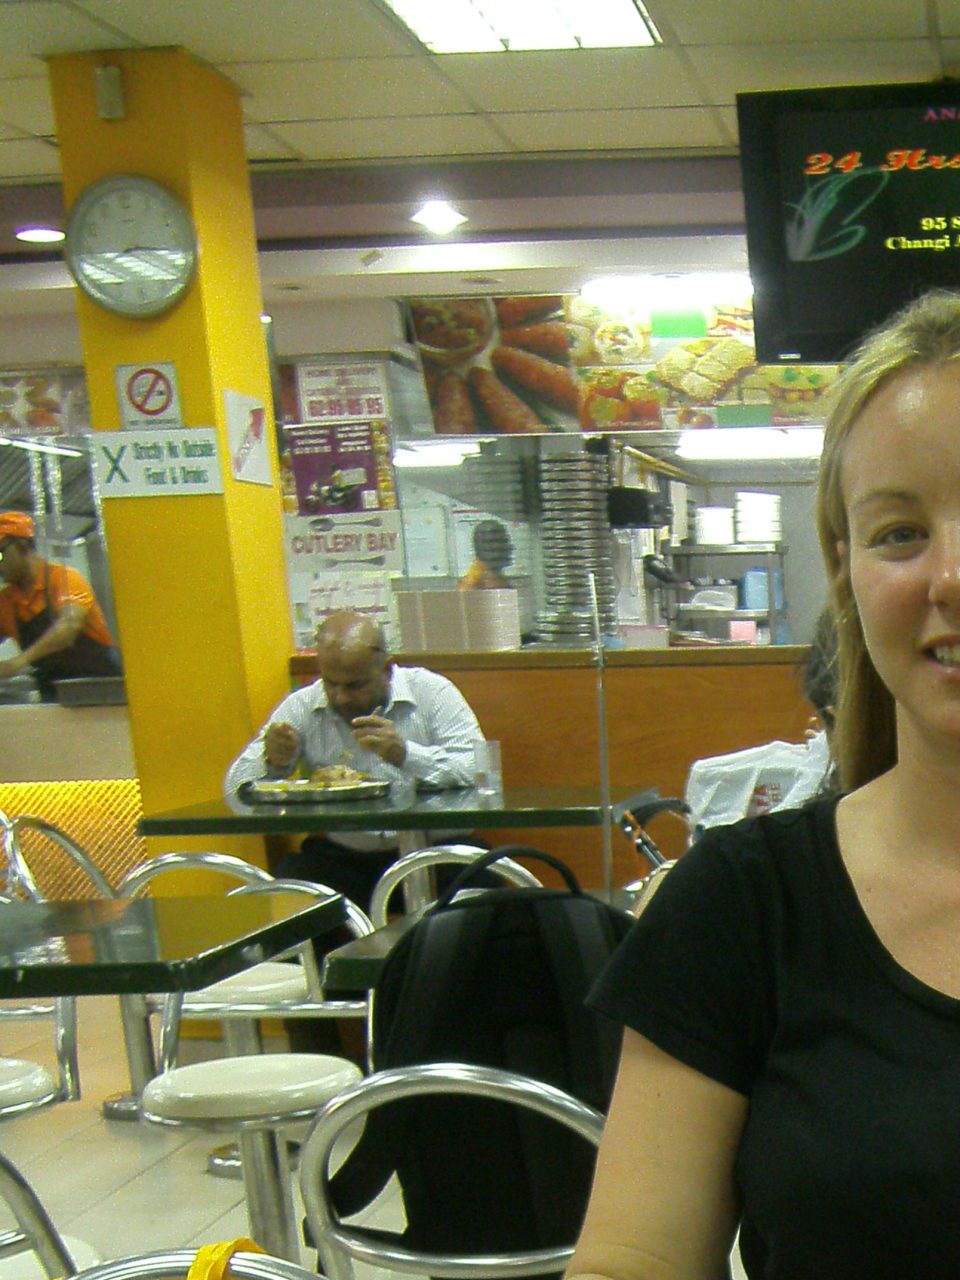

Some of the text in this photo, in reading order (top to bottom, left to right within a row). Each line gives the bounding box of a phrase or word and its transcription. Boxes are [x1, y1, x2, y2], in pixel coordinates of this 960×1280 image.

[805, 152, 863, 174] 24
[920, 216, 948, 231] 95
[885, 234, 951, 251] Changi
[290, 531, 399, 555] CUTLERY BAY
